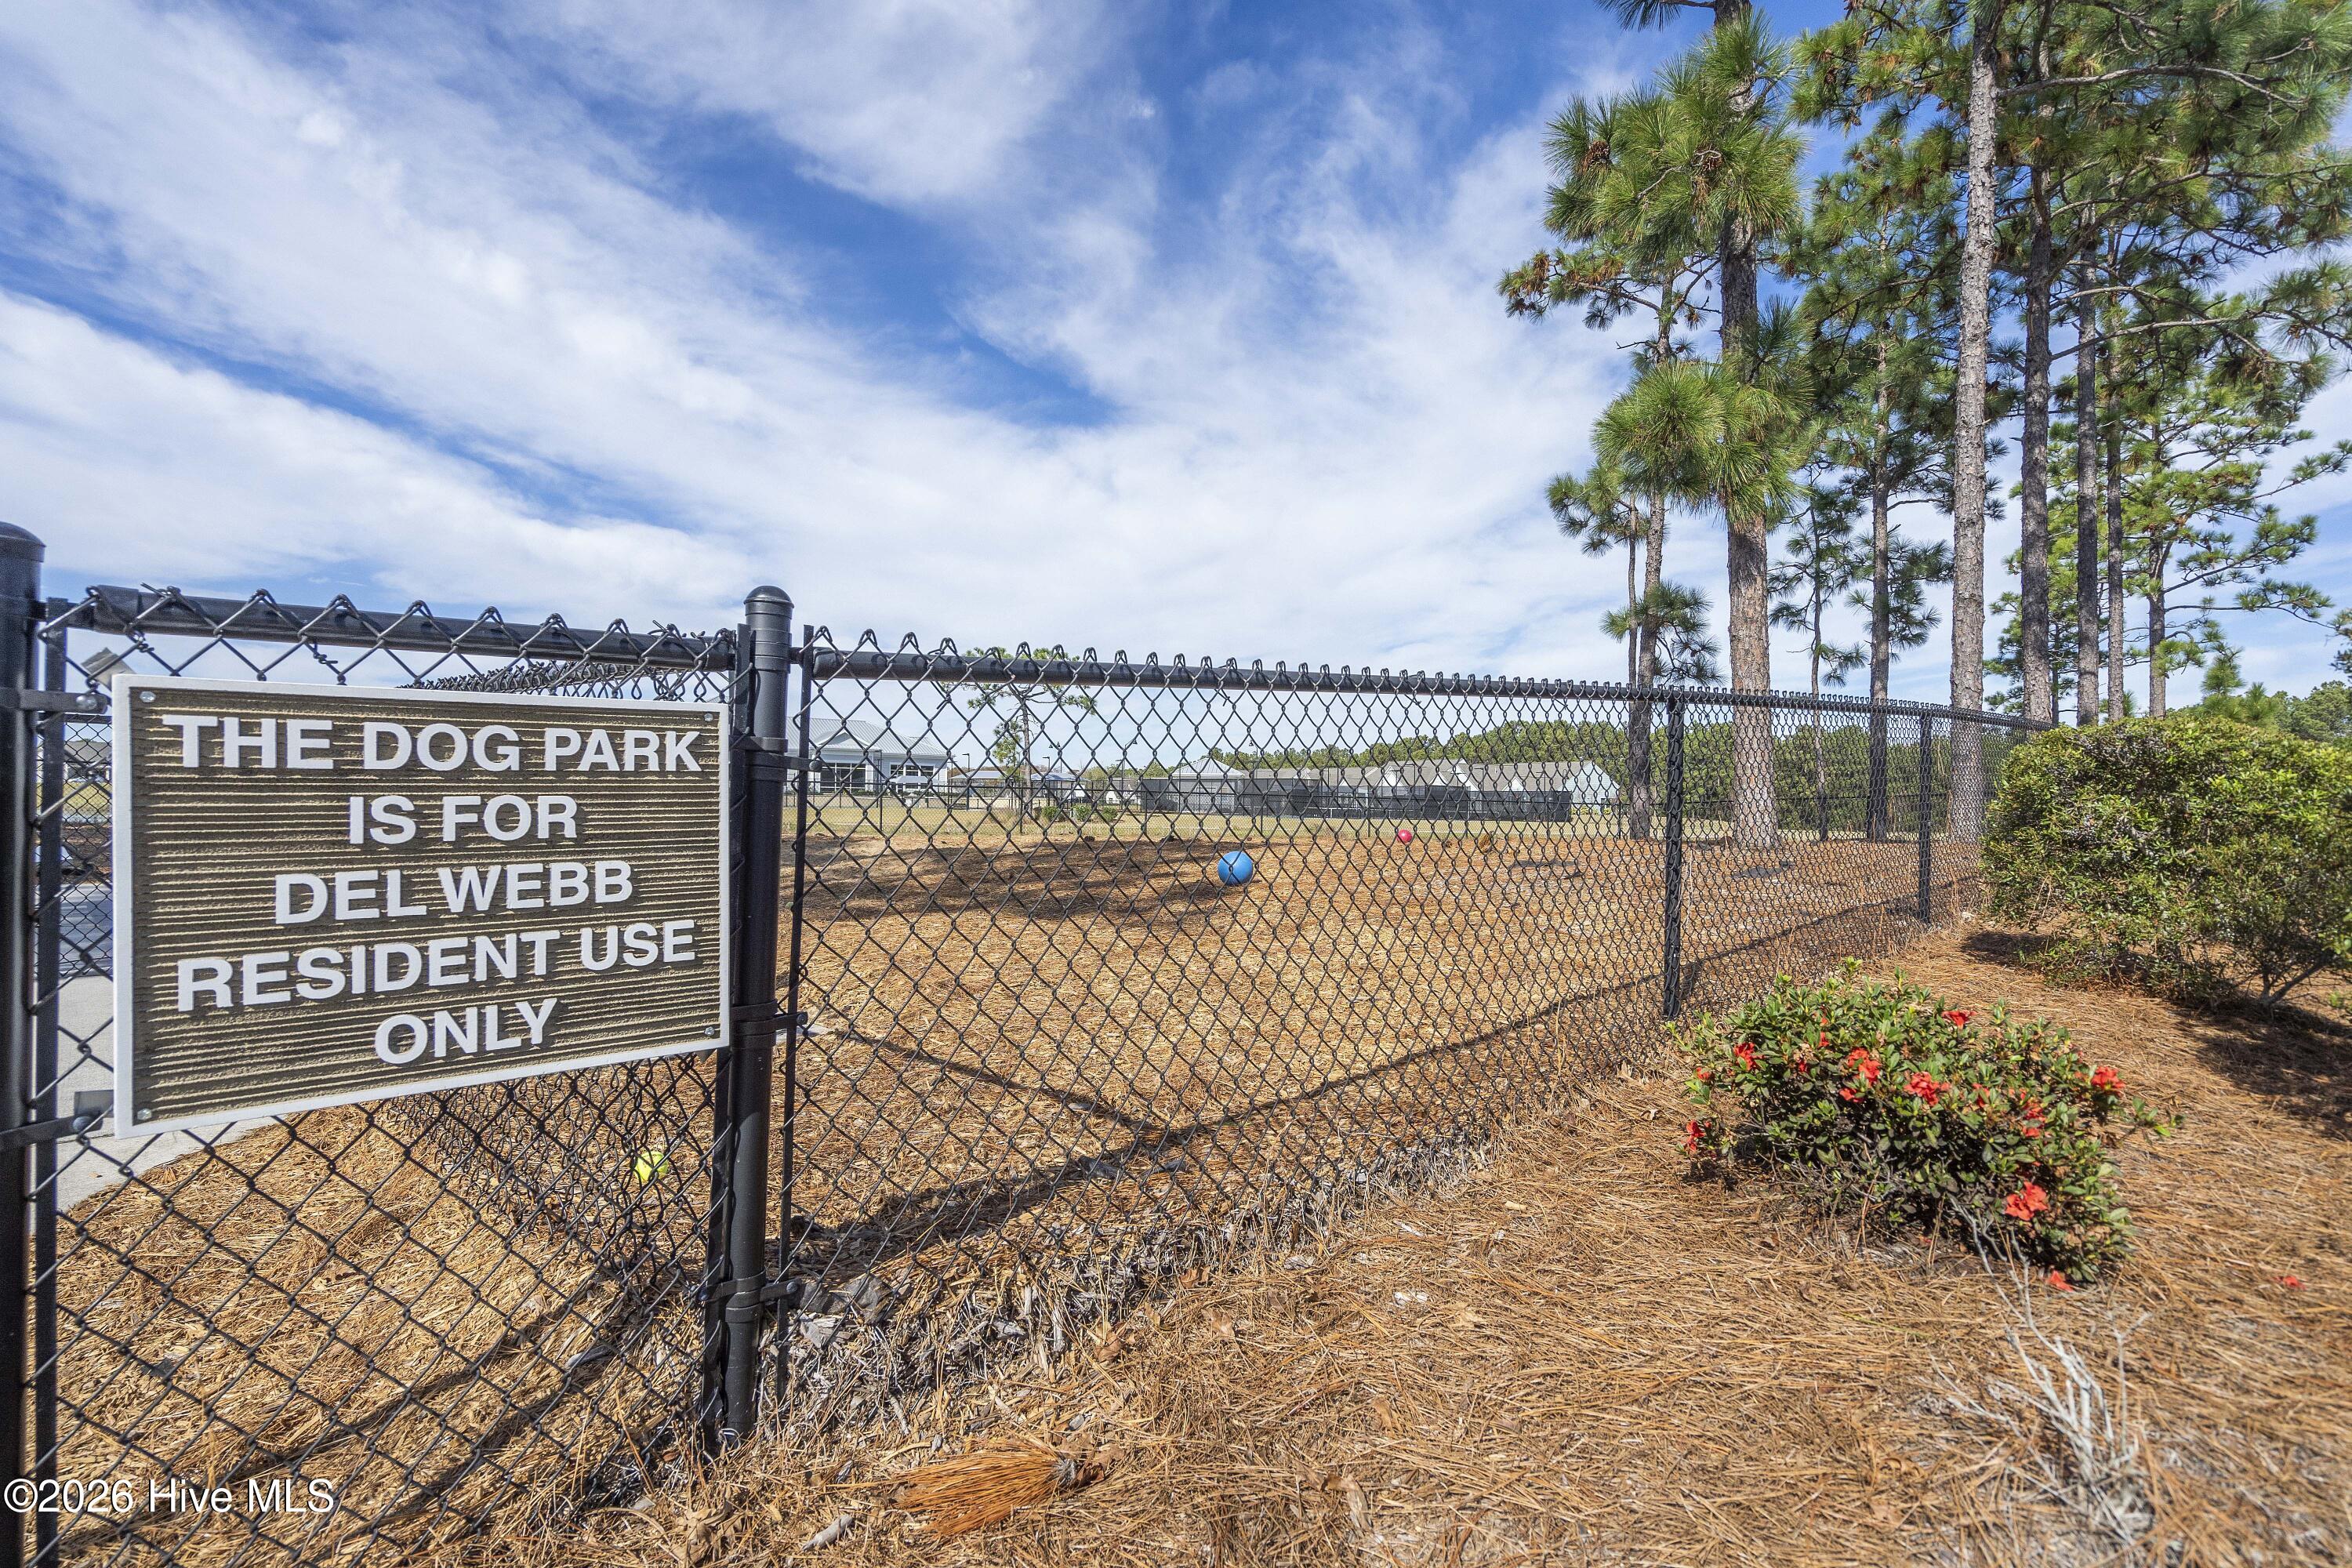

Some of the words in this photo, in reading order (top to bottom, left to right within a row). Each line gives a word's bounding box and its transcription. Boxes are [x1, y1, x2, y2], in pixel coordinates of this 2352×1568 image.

[162, 715, 334, 771] THE
[362, 721, 520, 771] DOG
[544, 728, 703, 772] PARK
[349, 794, 414, 844] IS
[442, 794, 578, 842] FOR
[274, 869, 427, 925] DEL
[437, 860, 633, 913] WEBB
[177, 929, 560, 1012] RESIDENT
[580, 919, 695, 971] USE
[375, 998, 557, 1064] ONLY
